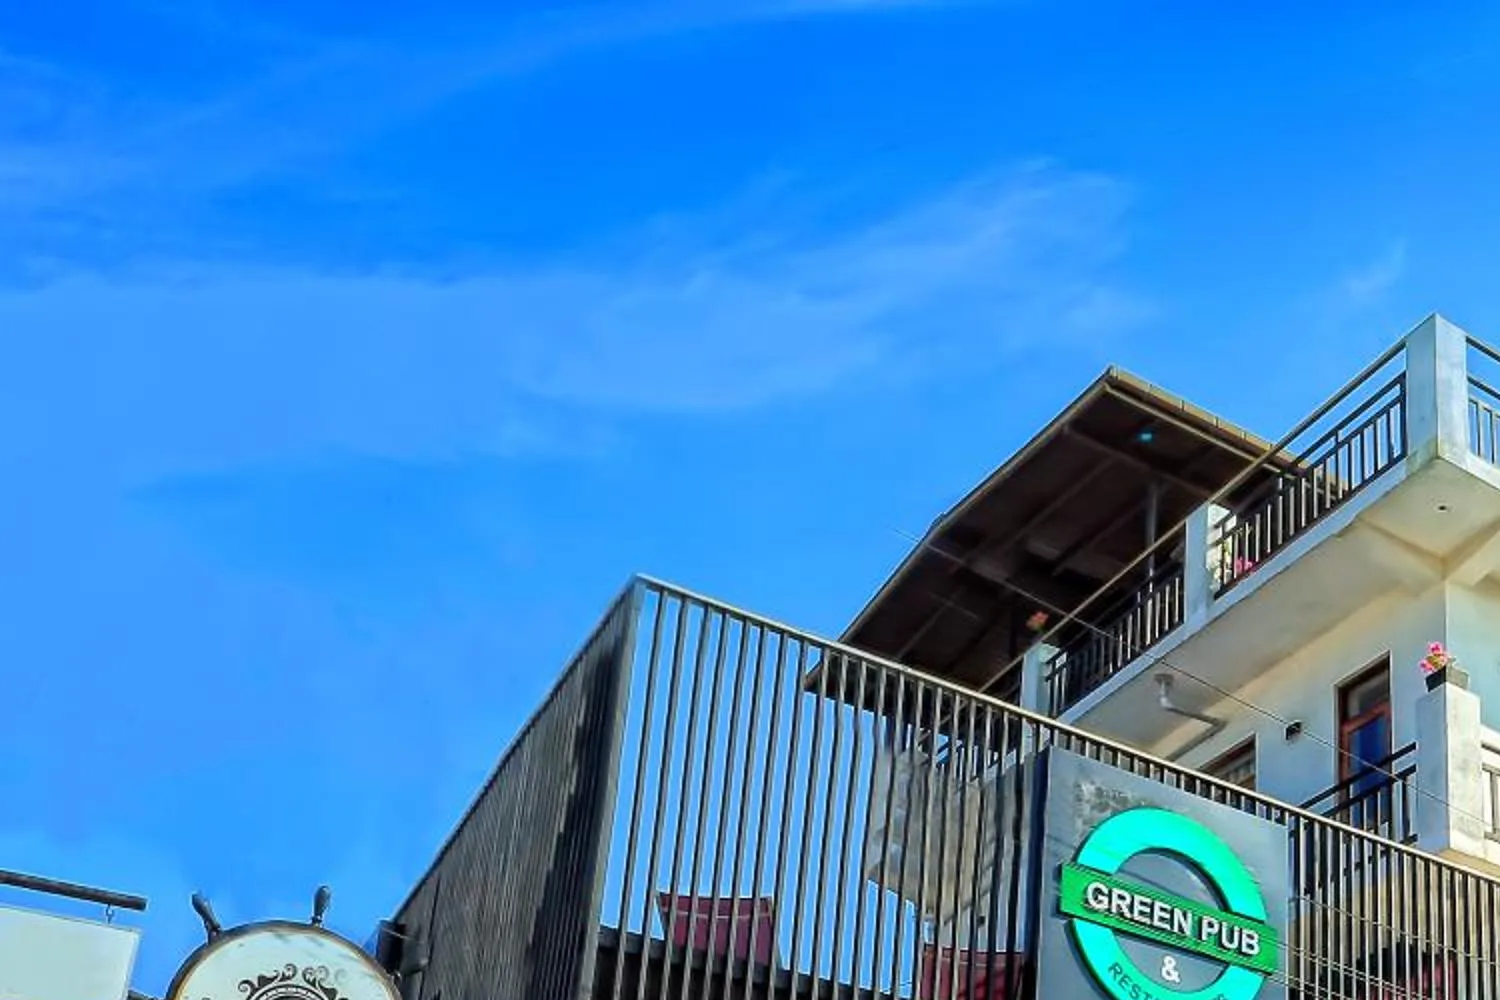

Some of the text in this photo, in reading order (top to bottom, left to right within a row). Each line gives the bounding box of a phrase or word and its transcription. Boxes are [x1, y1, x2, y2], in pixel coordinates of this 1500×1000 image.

[1086, 882, 1262, 957] GREEN PUB
[1161, 955, 1181, 984] &
